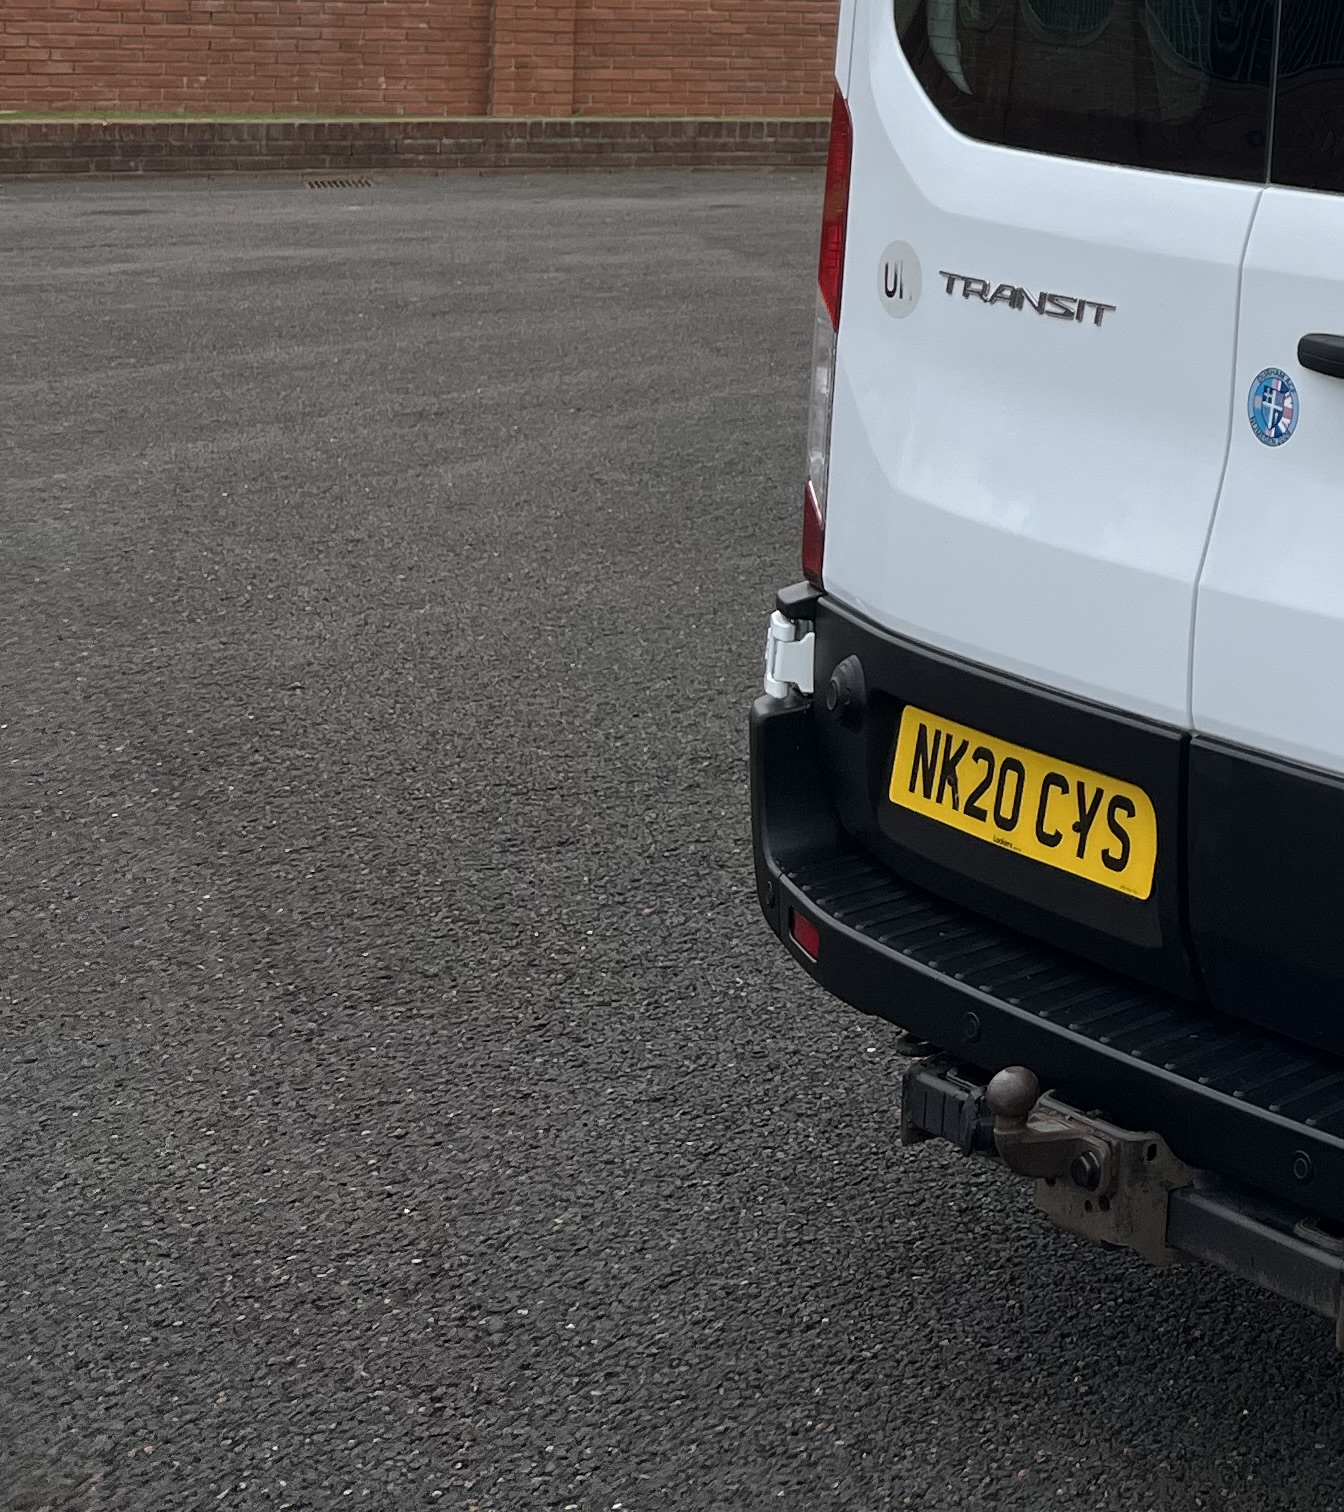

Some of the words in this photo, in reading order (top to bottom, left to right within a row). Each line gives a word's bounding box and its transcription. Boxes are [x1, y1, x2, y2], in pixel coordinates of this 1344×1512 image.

[938, 270, 1117, 327] TRANSIT
[908, 723, 1026, 832] NK20
[1035, 771, 1136, 873] CYS
